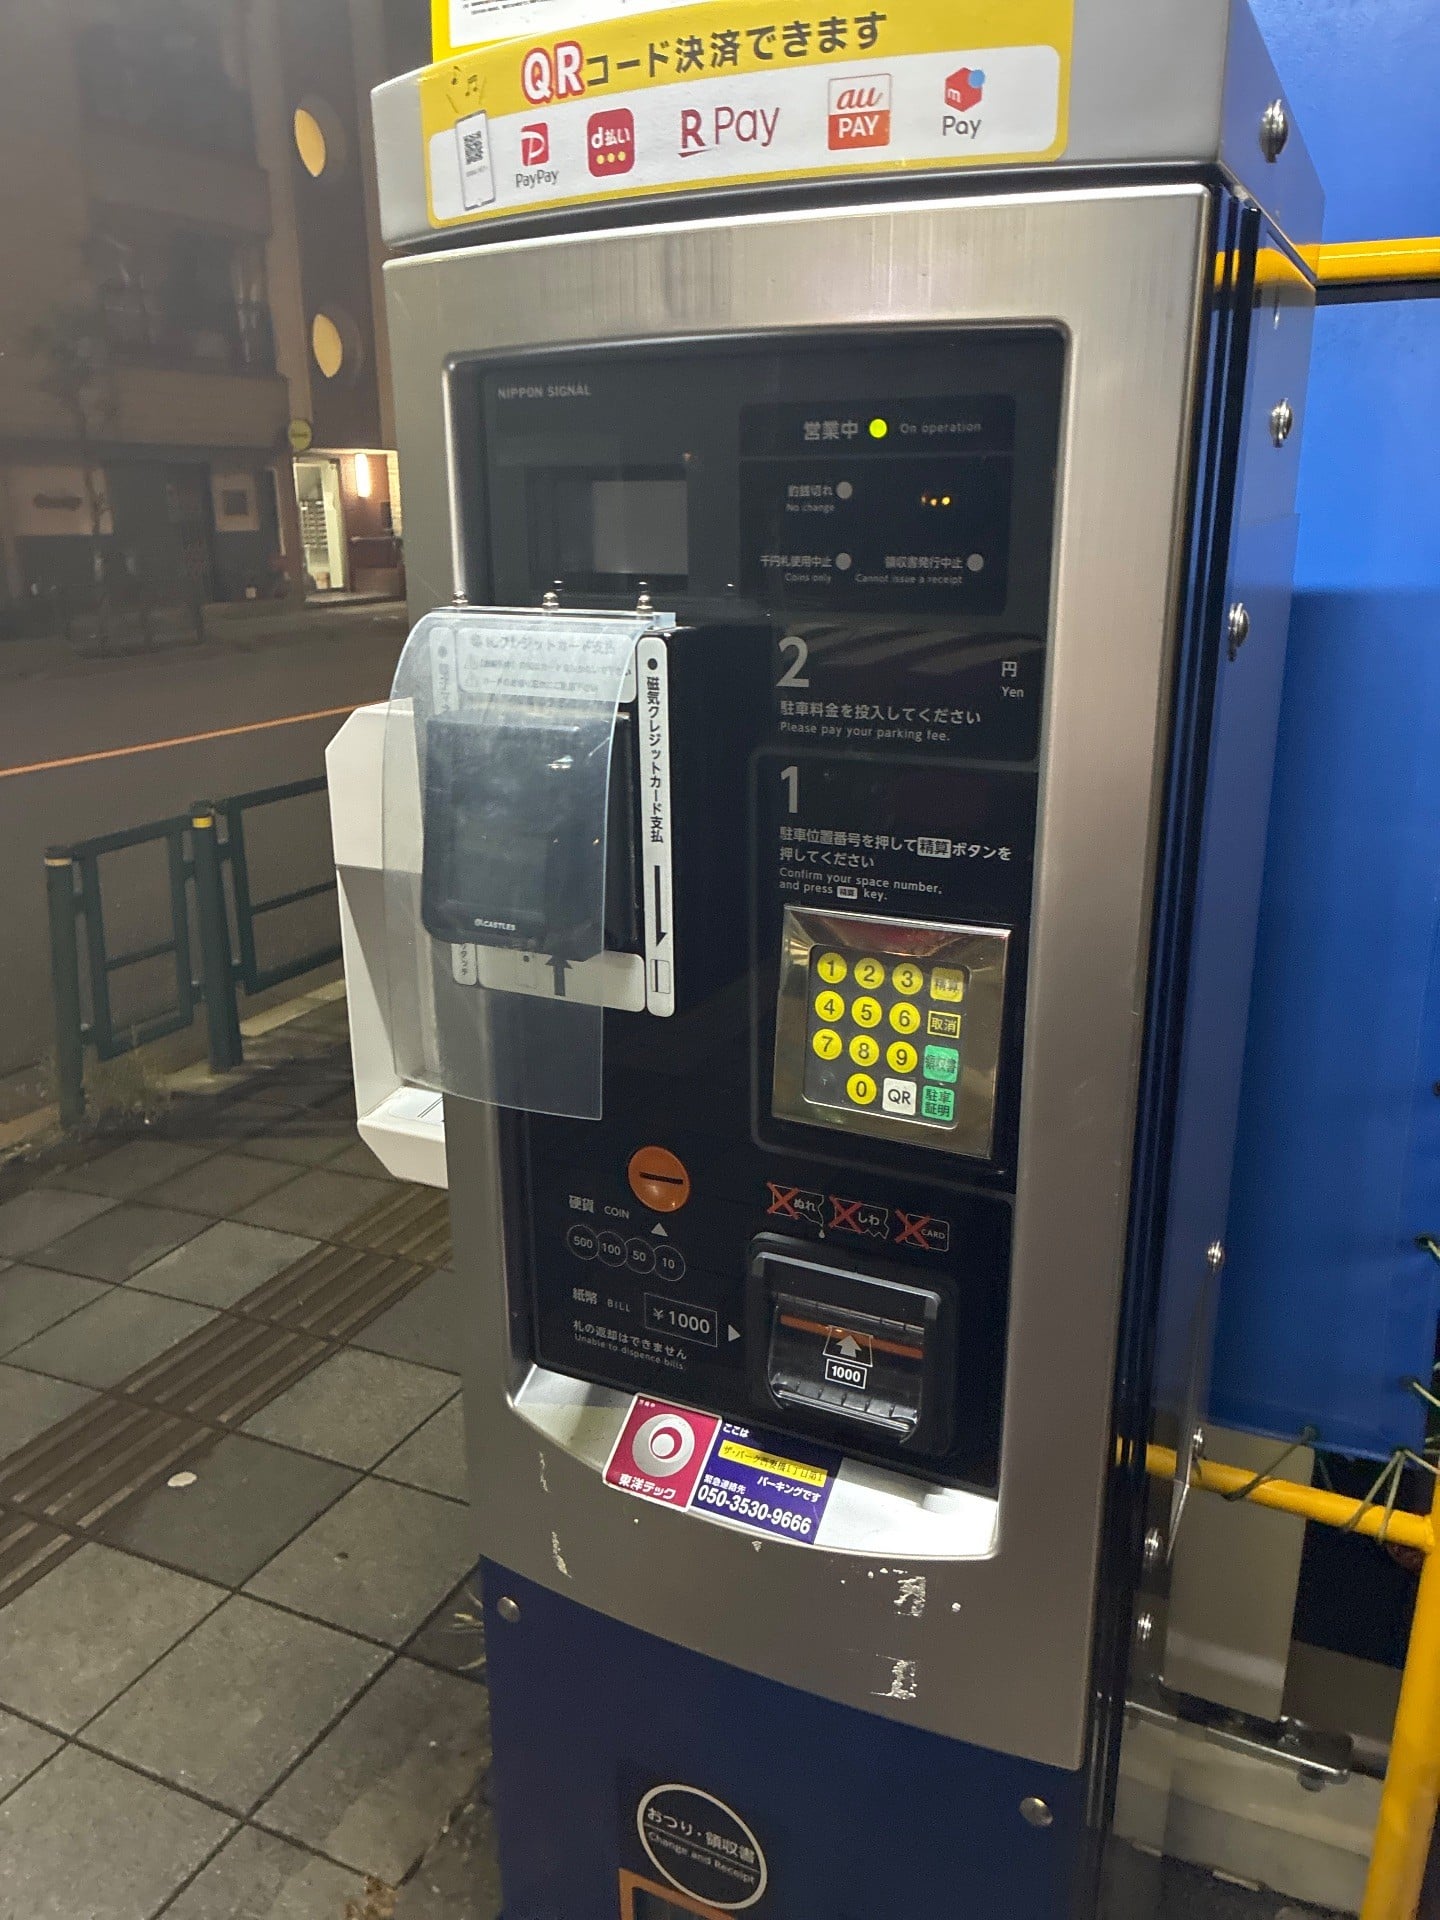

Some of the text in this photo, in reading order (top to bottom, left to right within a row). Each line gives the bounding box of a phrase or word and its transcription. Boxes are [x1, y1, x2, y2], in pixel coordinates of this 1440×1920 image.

[836, 87, 883, 110] au
[714, 106, 780, 147] Pay
[838, 116, 878, 139] PAY
[943, 115, 982, 140] Pay
[591, 127, 631, 148] d払い
[515, 169, 560, 190] PayPay
[498, 384, 592, 399] NIPPON SIGNAL
[804, 420, 859, 441] 営業中
[900, 422, 981, 435] On operation
[776, 636, 810, 688] 2
[1001, 660, 1018, 678] 円
[1002, 685, 1024, 698] Yen
[780, 700, 981, 725] 駐車料金を投入してください
[780, 721, 951, 742] Please pay your parking fee.
[780, 766, 798, 814] 1
[779, 847, 874, 868] 押してください
[779, 867, 823, 881] Confirm
[826, 872, 852, 885] your
[855, 875, 889, 889] space
[779, 879, 800, 891] and
[803, 882, 833, 895] press
[826, 960, 835, 977] 1
[863, 965, 875, 983] 2
[901, 970, 913, 988] 3
[824, 999, 835, 1016] 4
[861, 1004, 872, 1021] 5
[899, 1010, 910, 1027] 6
[931, 1017, 956, 1033] 取消
[821, 1036, 833, 1053] 7
[858, 1043, 870, 1060] 8
[896, 1049, 908, 1066] 9
[855, 1081, 867, 1098] 0
[887, 1088, 911, 1106] QR
[925, 1089, 951, 1104] 駐車
[603, 1205, 631, 1220] COIN
[858, 1210, 880, 1226] しわ
[921, 1228, 946, 1240] CARD
[573, 1236, 676, 1270] 500 100 50 10
[607, 1298, 631, 1313] BILL
[573, 1319, 688, 1361] 札の返却はできません
[574, 1332, 606, 1350] Unable
[608, 1342, 619, 1353] to
[831, 1365, 861, 1383] 1000
[723, 1422, 750, 1439] ここは
[618, 1473, 677, 1500] 東洋テック
[703, 1473, 747, 1495] 緊急連絡先
[757, 1475, 822, 1503] パーキングです
[697, 1484, 812, 1535] 050-3530-9666
